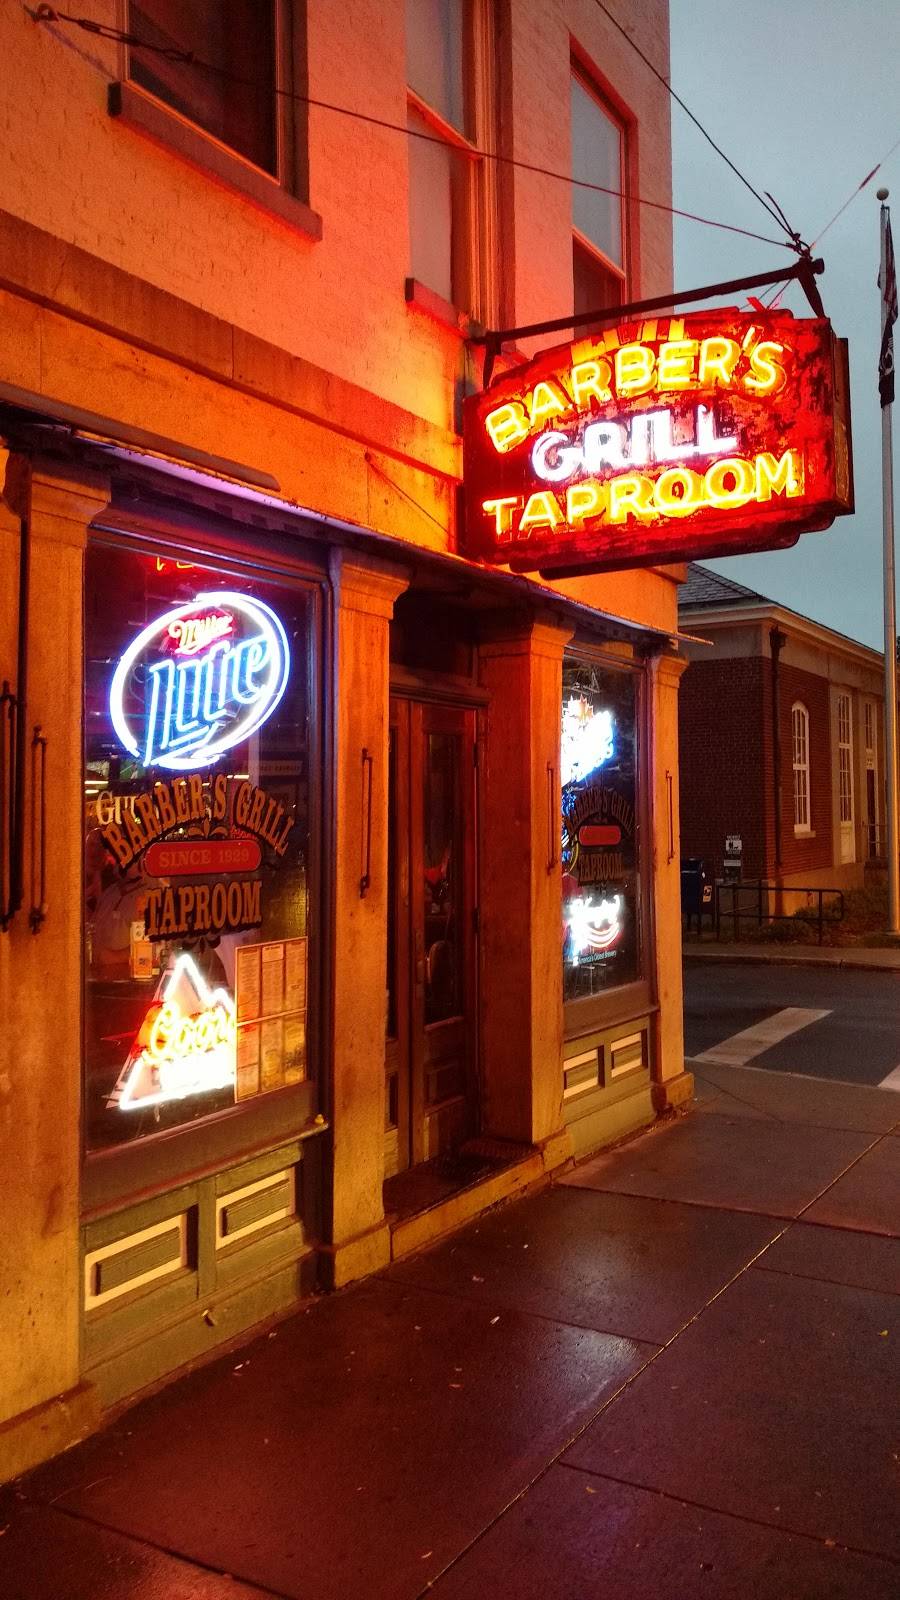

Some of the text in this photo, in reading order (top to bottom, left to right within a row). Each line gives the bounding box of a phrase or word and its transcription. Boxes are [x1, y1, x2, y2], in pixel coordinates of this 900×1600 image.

[484, 326, 789, 454] BARBER'S
[530, 403, 739, 483] GRILL
[482, 448, 806, 543] TAPROOM
[102, 774, 228, 870] BARBER'S
[235, 782, 295, 857] GRILL
[158, 848, 250, 868] SINCE 1929
[146, 880, 263, 938] TAPROOM
